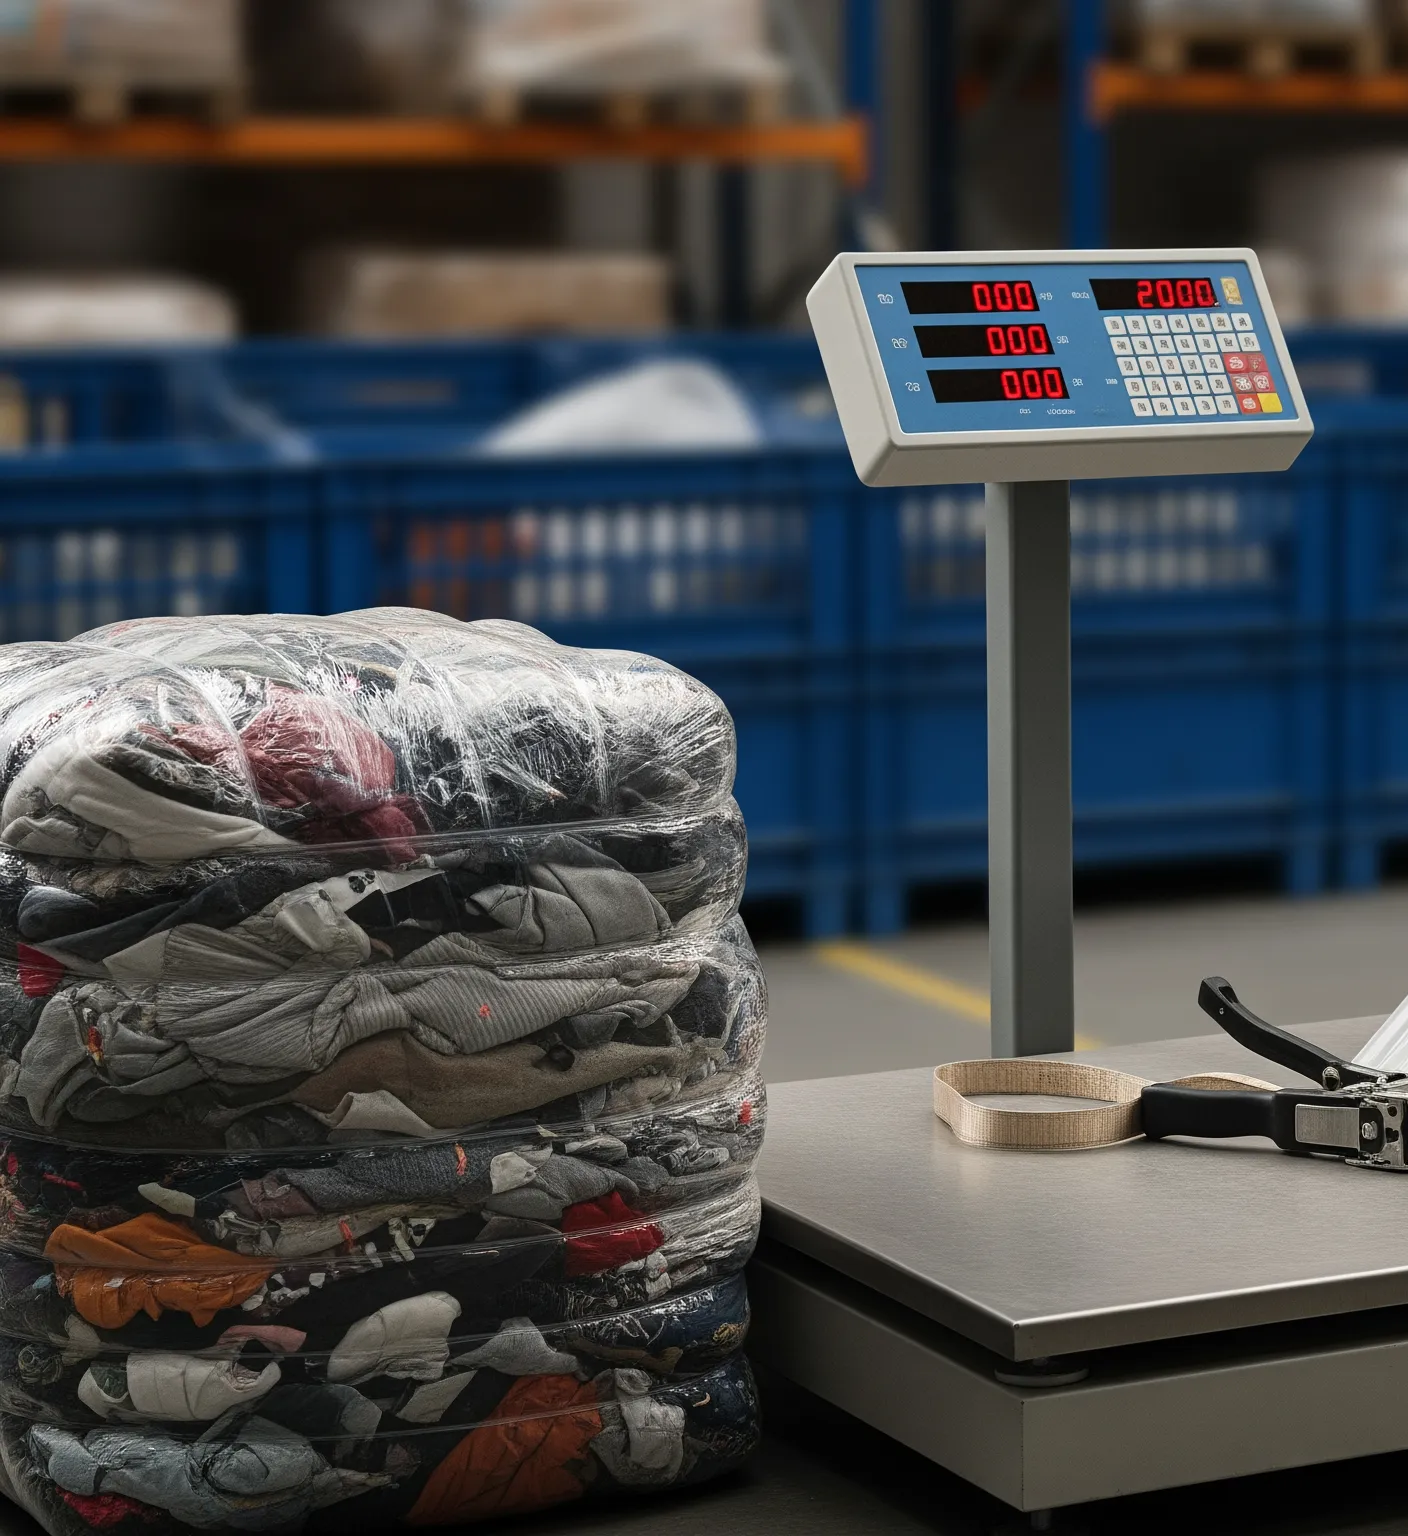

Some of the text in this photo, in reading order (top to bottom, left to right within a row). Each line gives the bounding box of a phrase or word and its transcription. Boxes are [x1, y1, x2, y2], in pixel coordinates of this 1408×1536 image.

[971, 282, 1035, 312] 000
[1136, 279, 1215, 308] 2000
[985, 325, 1049, 355] 000
[1000, 369, 1064, 400] 000
